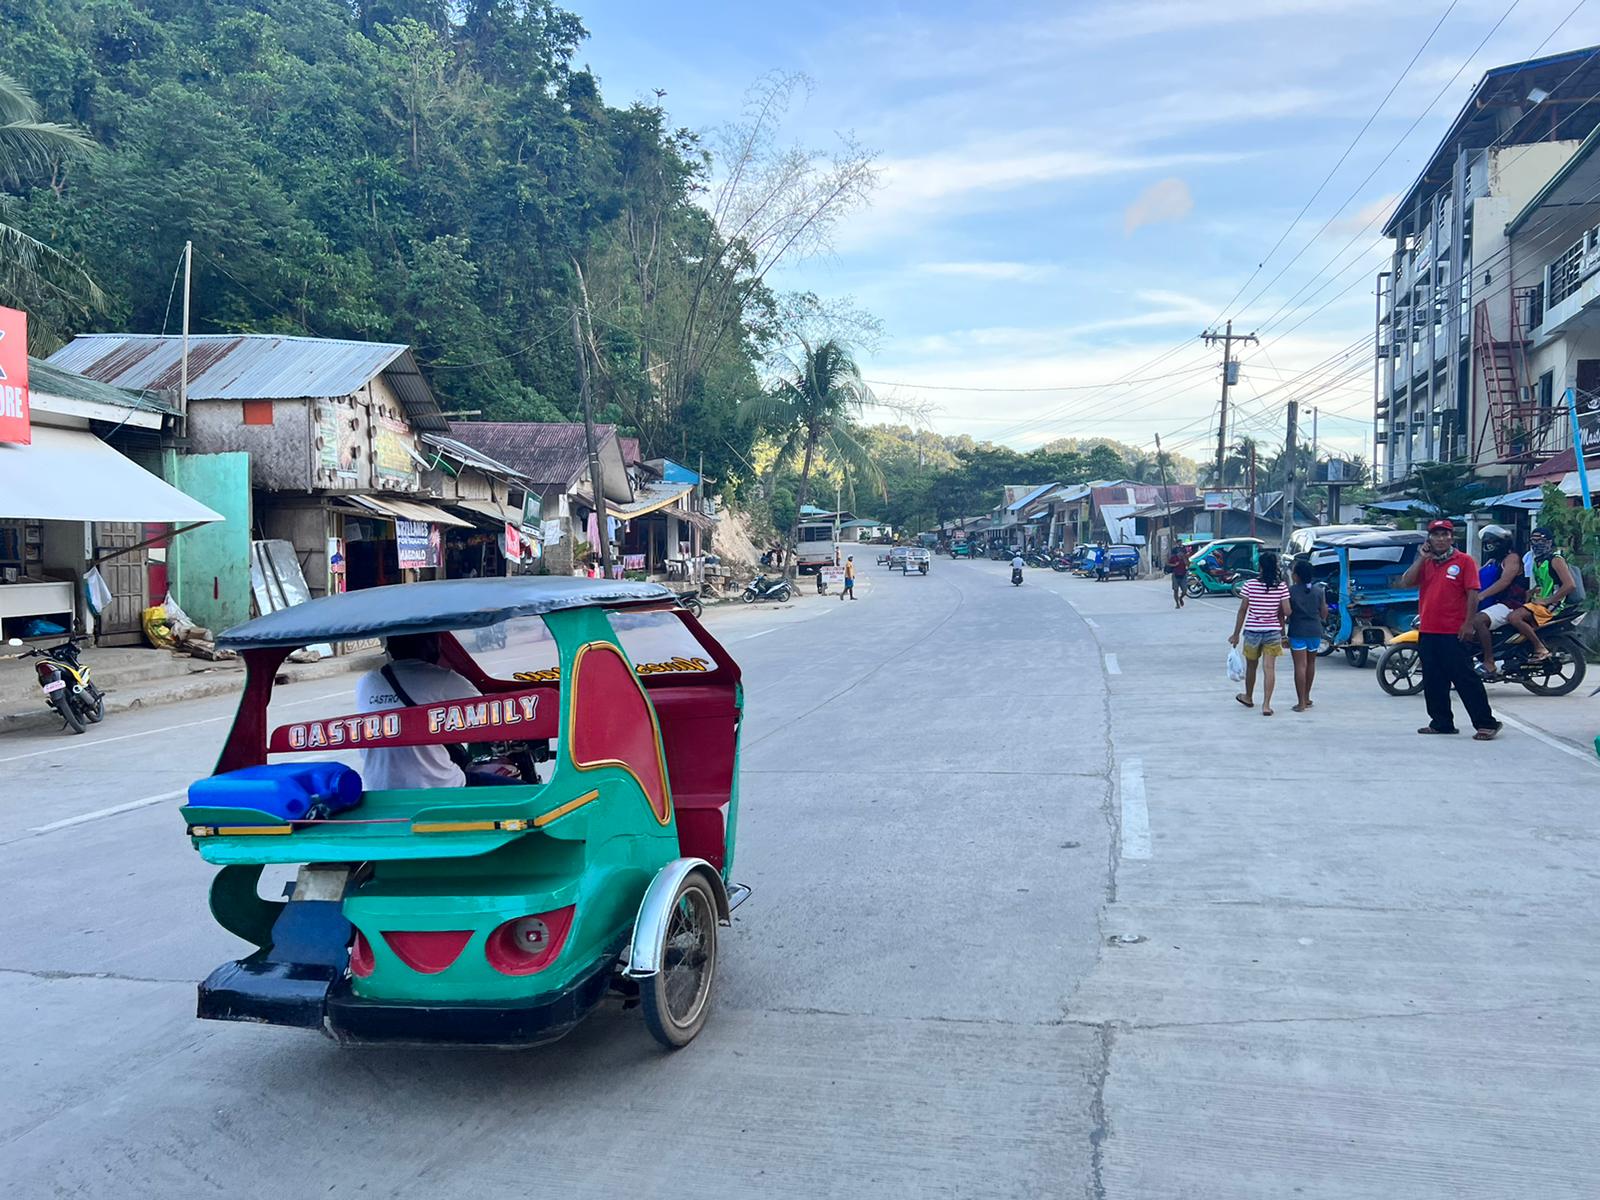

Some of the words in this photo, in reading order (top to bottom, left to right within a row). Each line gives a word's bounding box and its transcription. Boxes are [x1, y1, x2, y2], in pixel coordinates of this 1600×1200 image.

[369, 694, 399, 705] CASTRO
[288, 713, 402, 750] CASTRO
[427, 695, 541, 735] FAMILY
